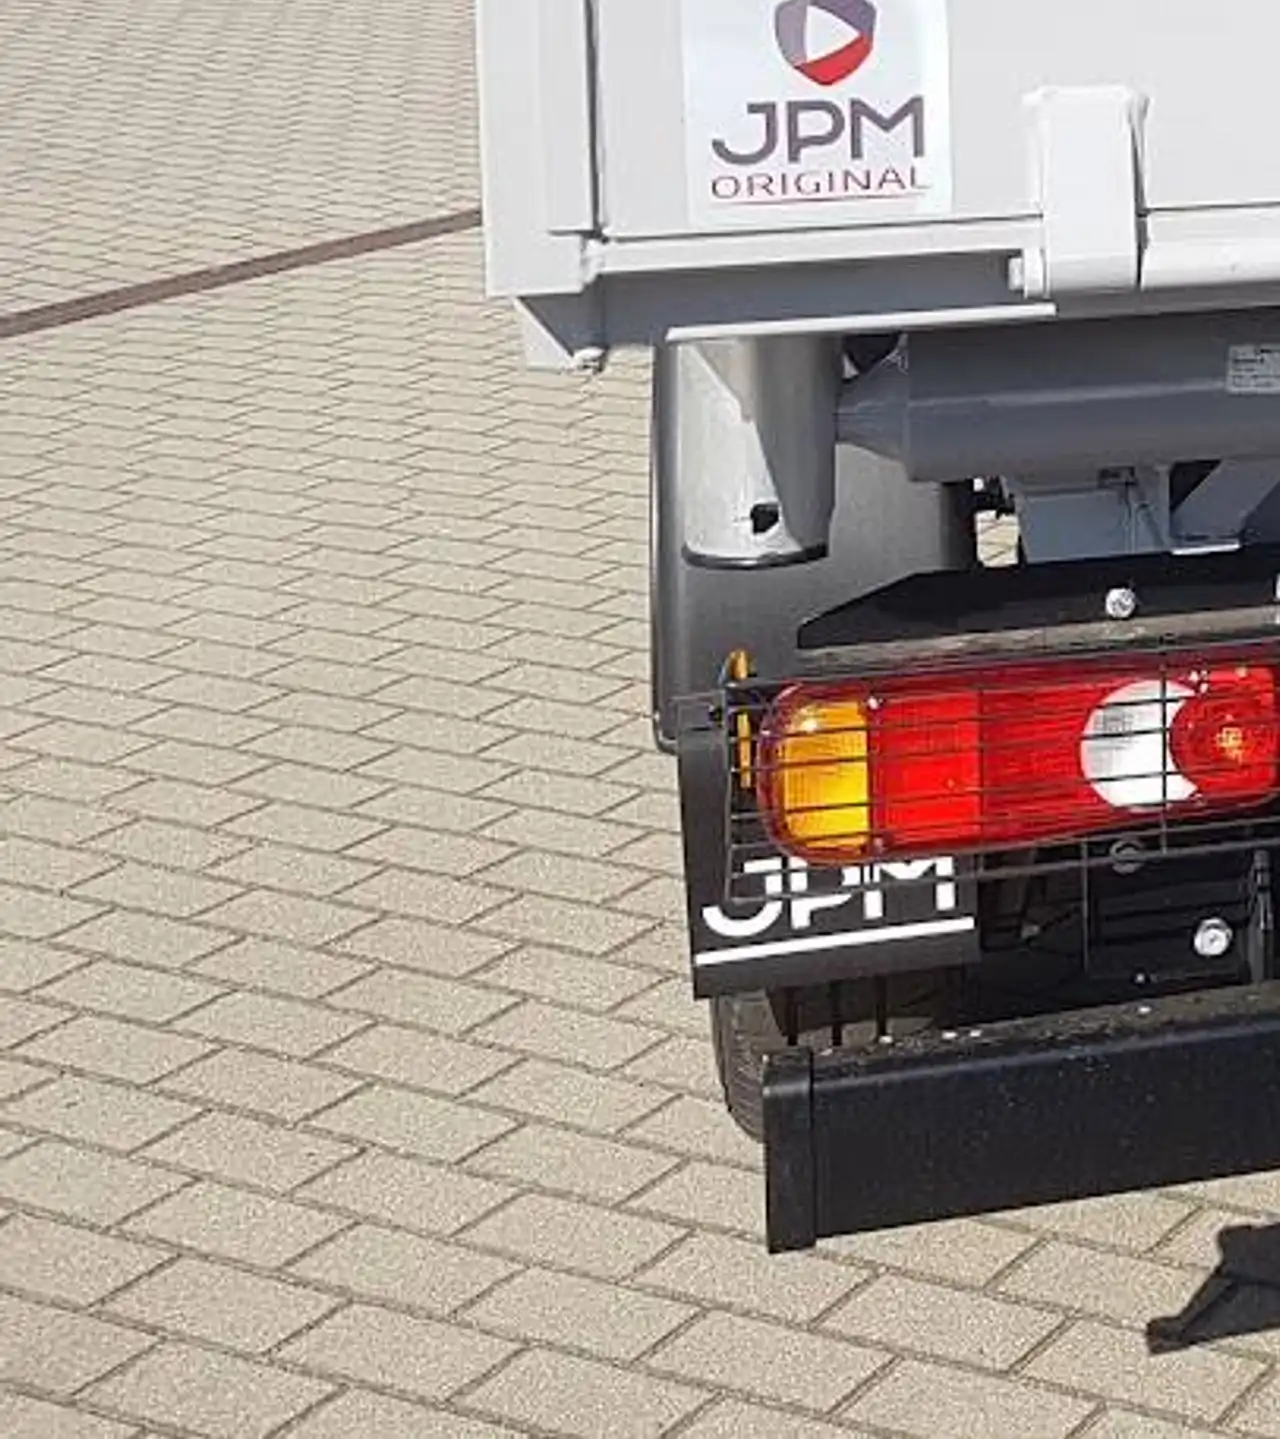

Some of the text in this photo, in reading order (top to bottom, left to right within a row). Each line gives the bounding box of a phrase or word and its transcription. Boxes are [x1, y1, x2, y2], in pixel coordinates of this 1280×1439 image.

[711, 95, 925, 166] JPM
[711, 167, 932, 199] ORIGINAL
[701, 856, 956, 938] JPM
